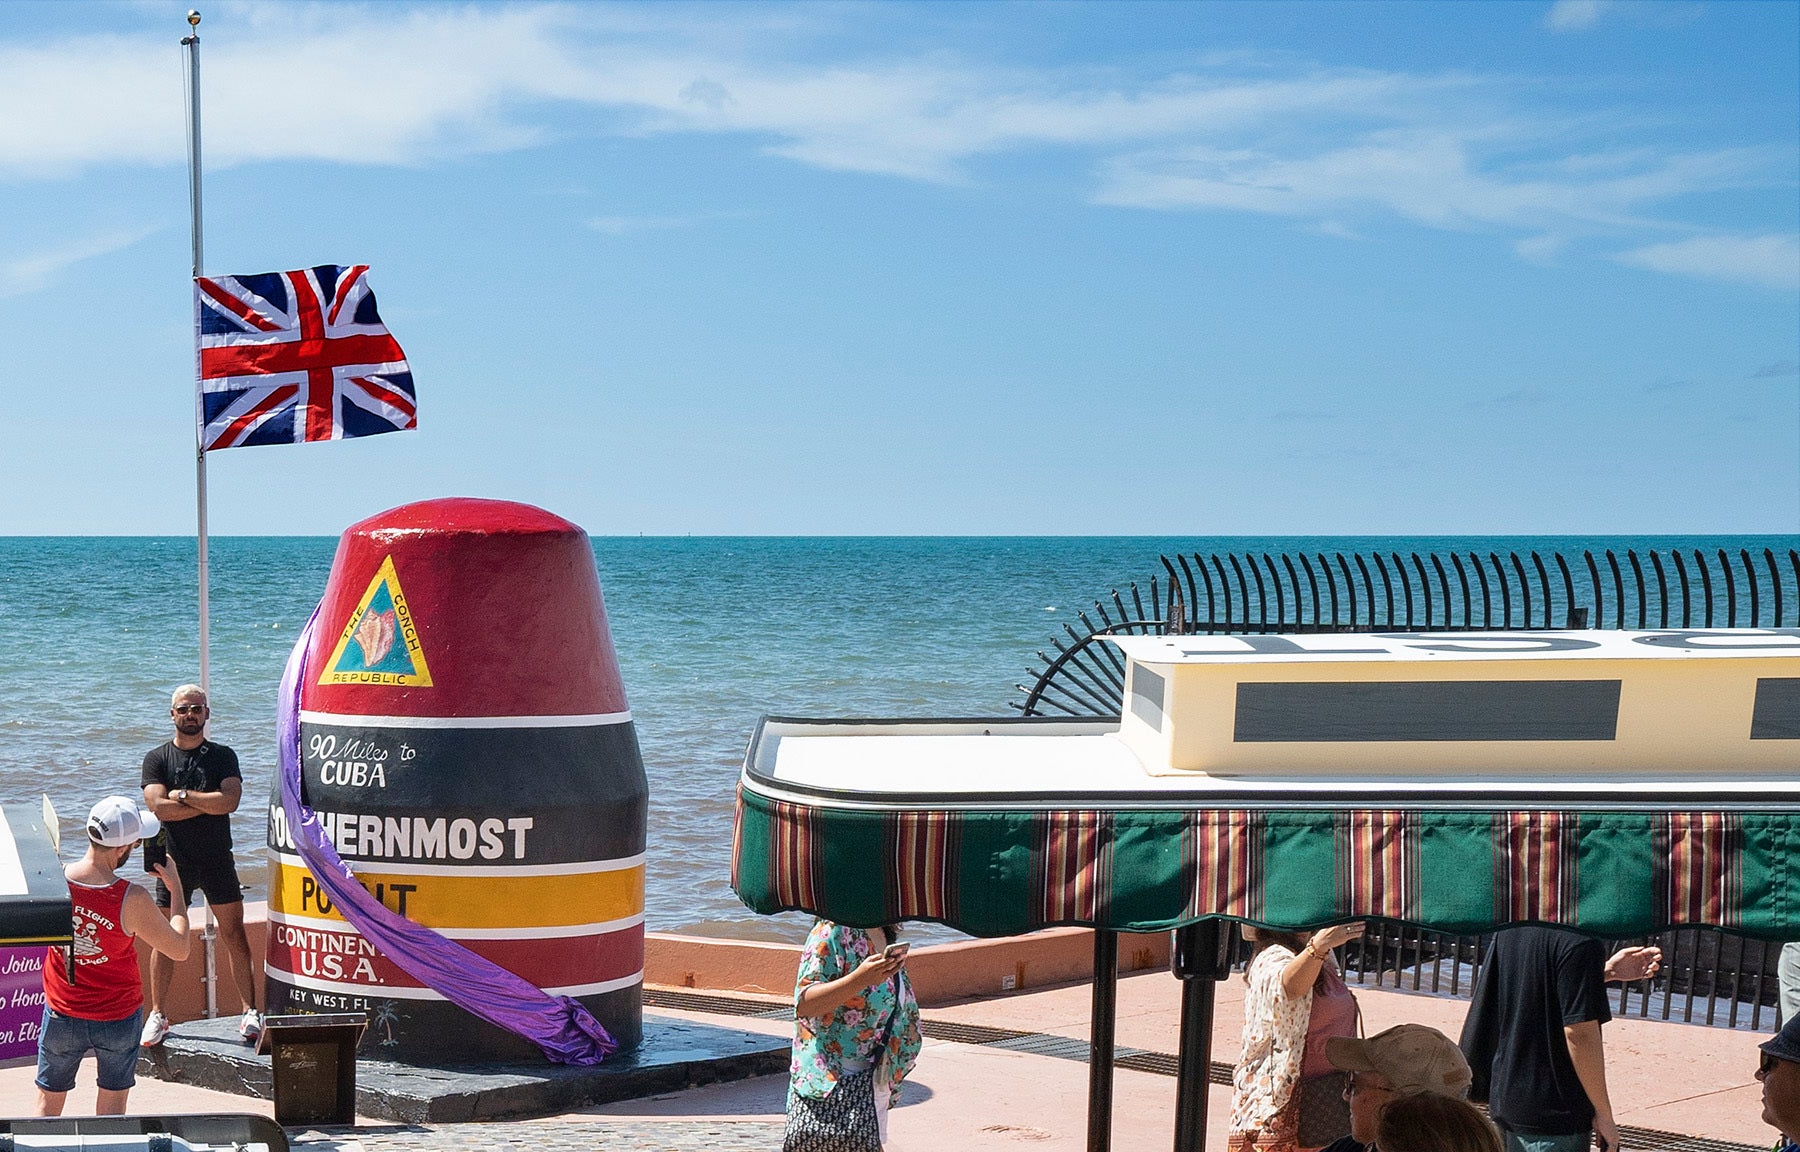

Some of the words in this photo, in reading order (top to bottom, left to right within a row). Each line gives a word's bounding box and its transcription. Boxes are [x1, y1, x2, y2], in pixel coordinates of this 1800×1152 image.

[342, 606, 364, 639] THE
[394, 594, 419, 652] CONCH
[332, 673, 406, 685] REPUBLIC
[308, 734, 336, 760] 90
[331, 738, 388, 761] Miles
[400, 742, 416, 761] to
[320, 760, 386, 788] CUBA
[302, 876, 417, 919] POT
[74, 905, 115, 931] FLIGHTS
[277, 925, 386, 957] CONTINEN
[2, 954, 42, 975] Joins
[301, 951, 384, 983] U.S.A.
[289, 988, 307, 1002] KEY
[312, 993, 349, 1011] WEST,
[354, 998, 371, 1010] FL
